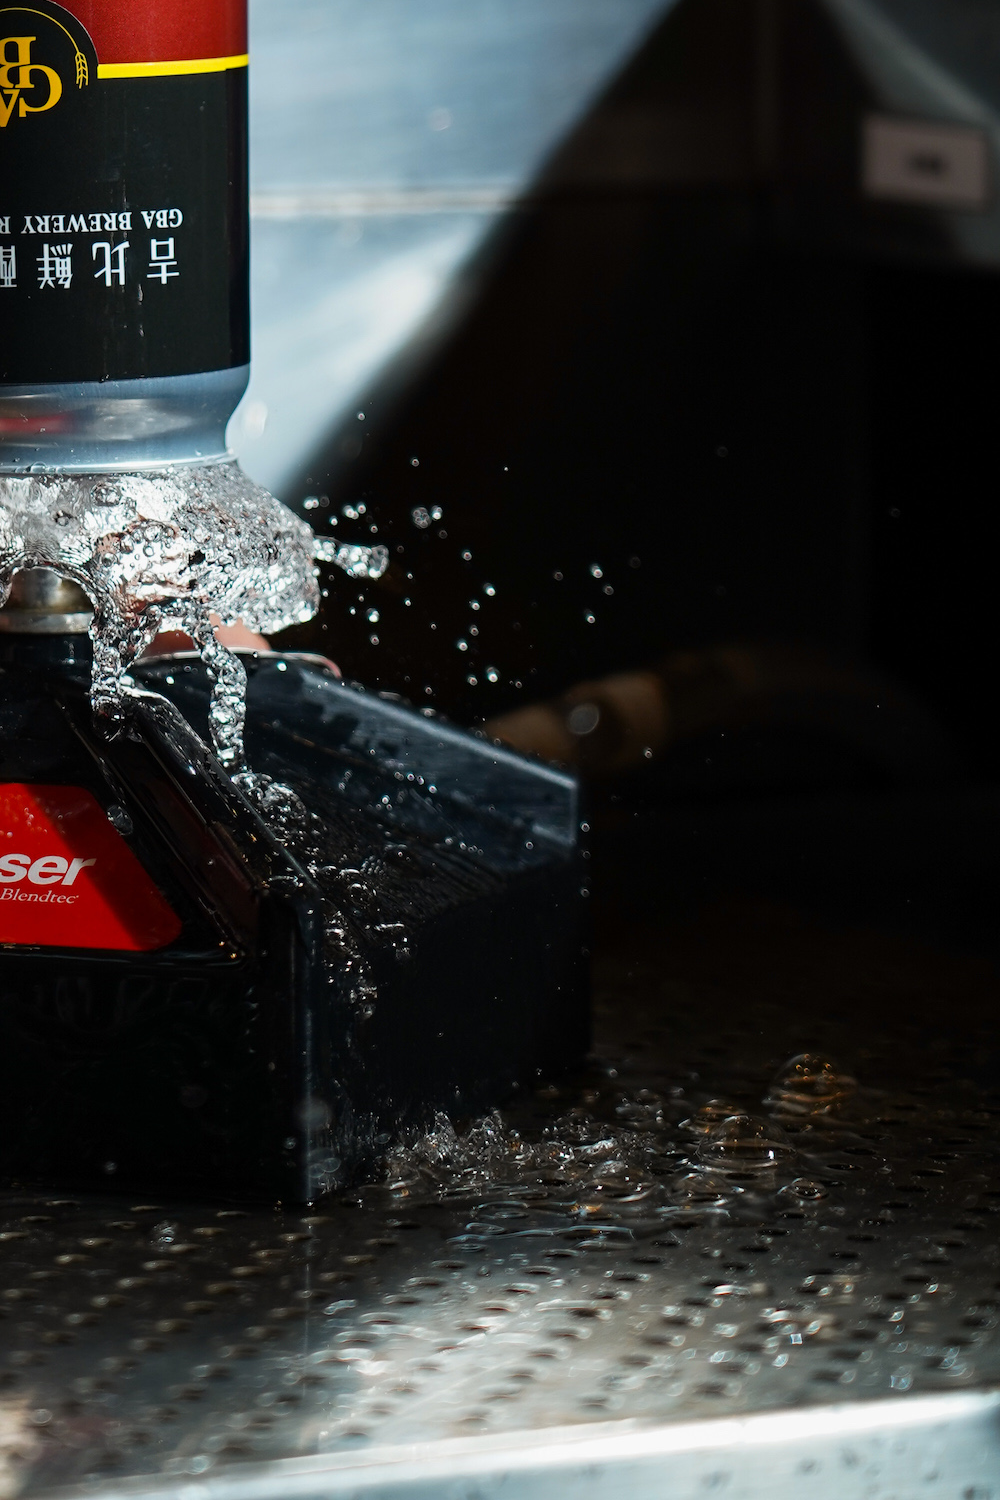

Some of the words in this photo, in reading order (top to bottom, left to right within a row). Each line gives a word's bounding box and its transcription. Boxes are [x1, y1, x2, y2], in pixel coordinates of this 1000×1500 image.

[20, 211, 132, 235] BREWERY
[141, 208, 184, 229] GBA
[0, 887, 75, 904] Blendtec
